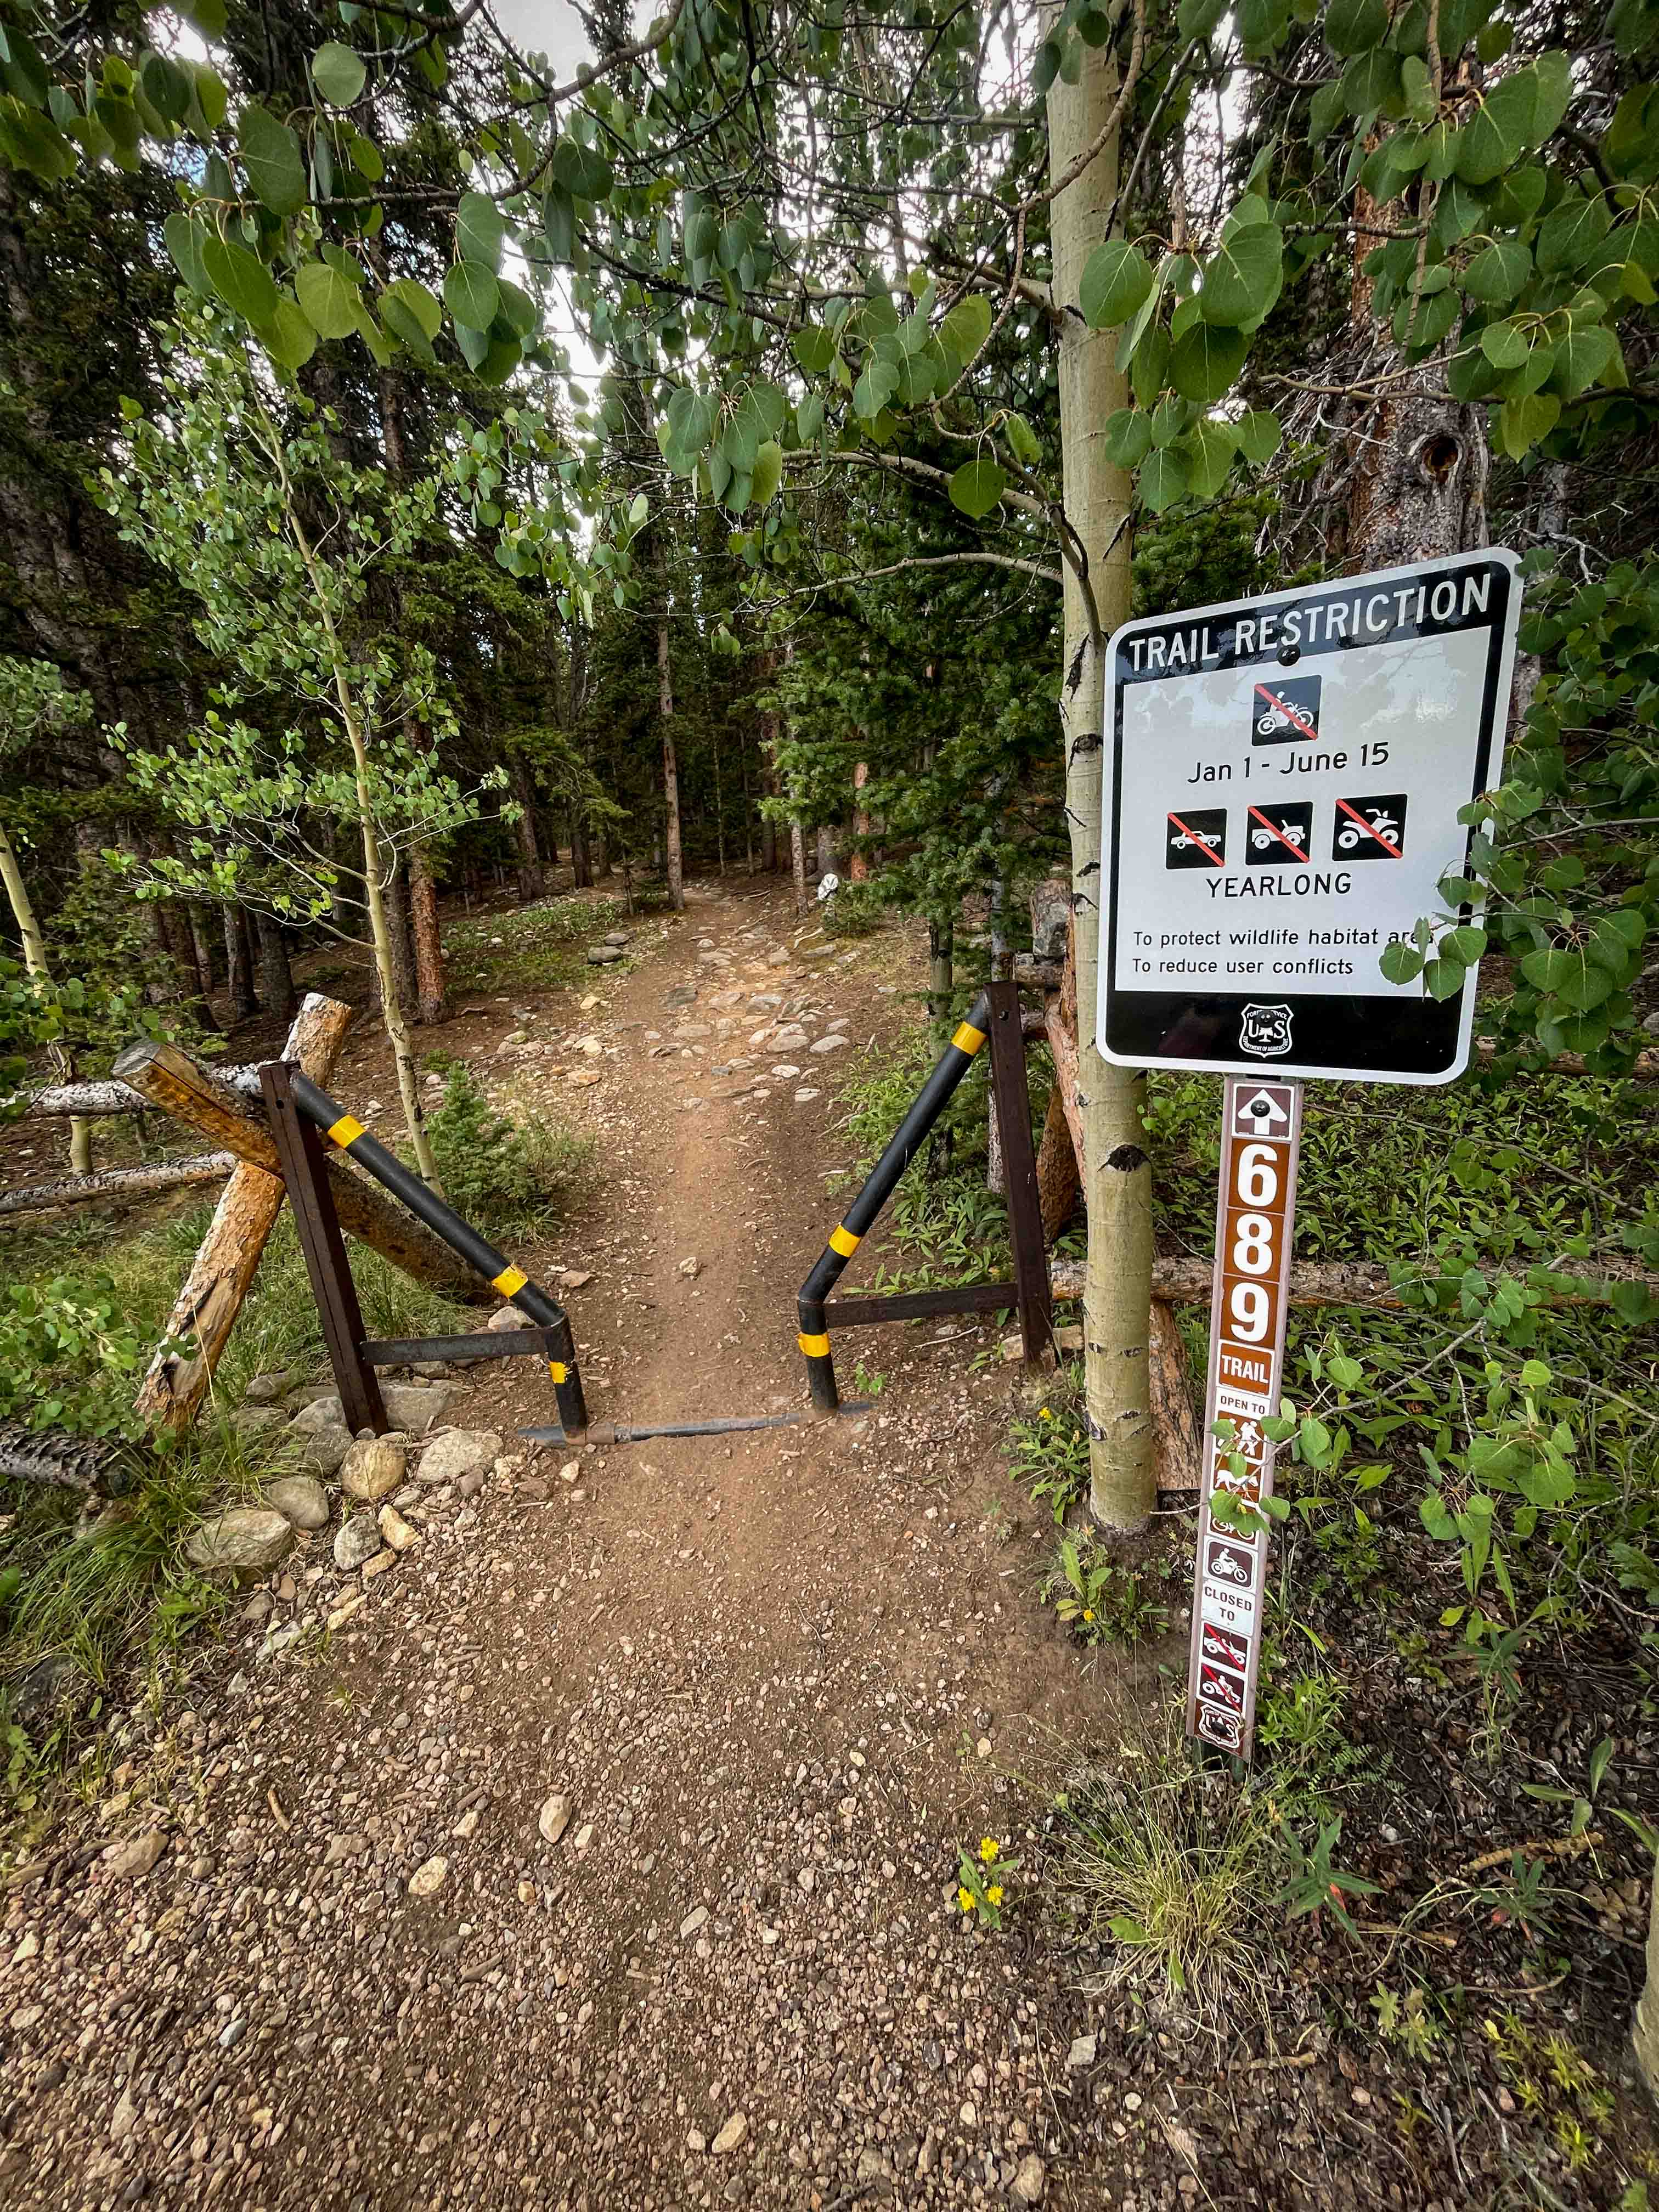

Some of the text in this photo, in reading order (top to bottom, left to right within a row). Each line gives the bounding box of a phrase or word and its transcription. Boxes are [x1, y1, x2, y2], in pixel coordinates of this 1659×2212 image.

[1129, 573, 1492, 672] TRAIL RESTRICTION
[1187, 762, 1232, 783] Jan
[1244, 757, 1250, 778] 1
[1279, 752, 1347, 774] June
[1361, 741, 1389, 766] 15
[1206, 872, 1351, 898] YEARLONG
[1133, 931, 1152, 946] To
[1160, 930, 1221, 949] protect
[1229, 929, 1299, 945] wildlife
[1308, 928, 1379, 945] habitat
[1132, 958, 1353, 974] To reduce user conflicts
[1221, 1355, 1269, 1384] TRAIL
[1220, 1395, 1265, 1414] OPEN TO
[1204, 1586, 1252, 1611] CLOSED
[1220, 1607, 1235, 1621] TO
